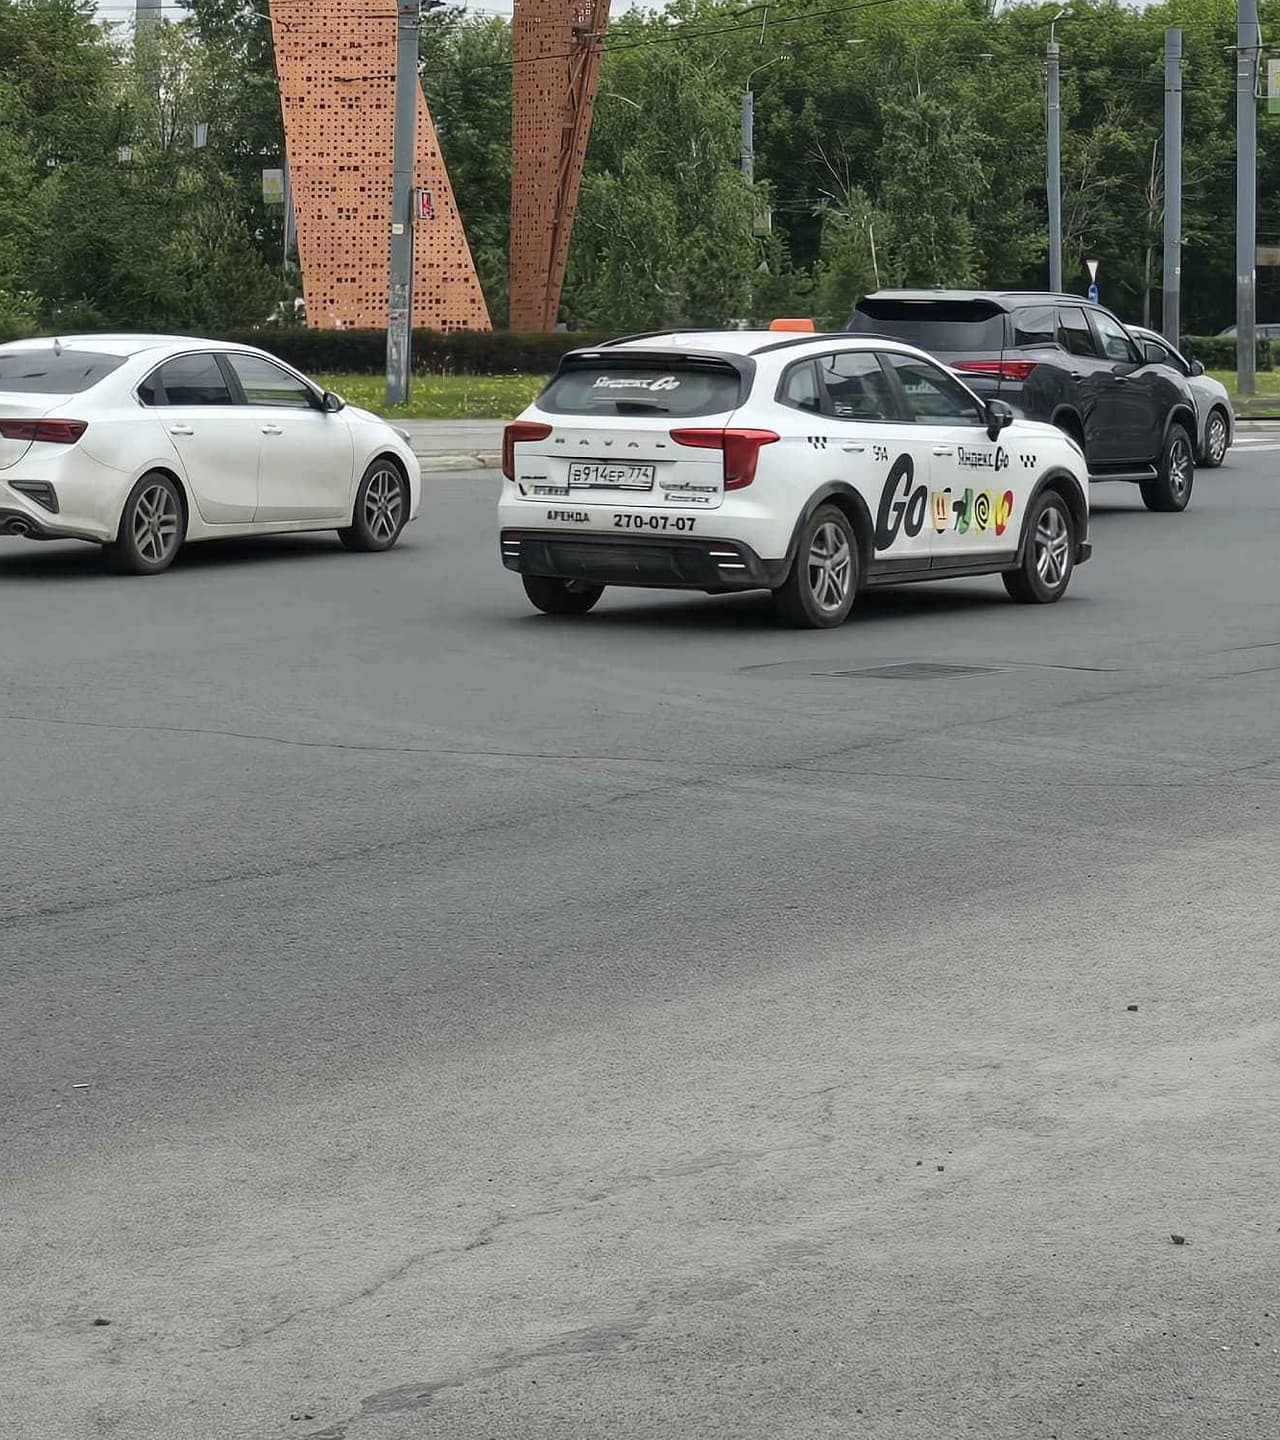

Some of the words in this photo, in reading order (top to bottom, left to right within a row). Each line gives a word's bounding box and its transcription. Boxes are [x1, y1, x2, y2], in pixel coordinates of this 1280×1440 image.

[995, 446, 1009, 471] Go
[876, 453, 928, 551] Go
[547, 510, 590, 523] АРЕНДА
[614, 514, 696, 532] 270-07-07
